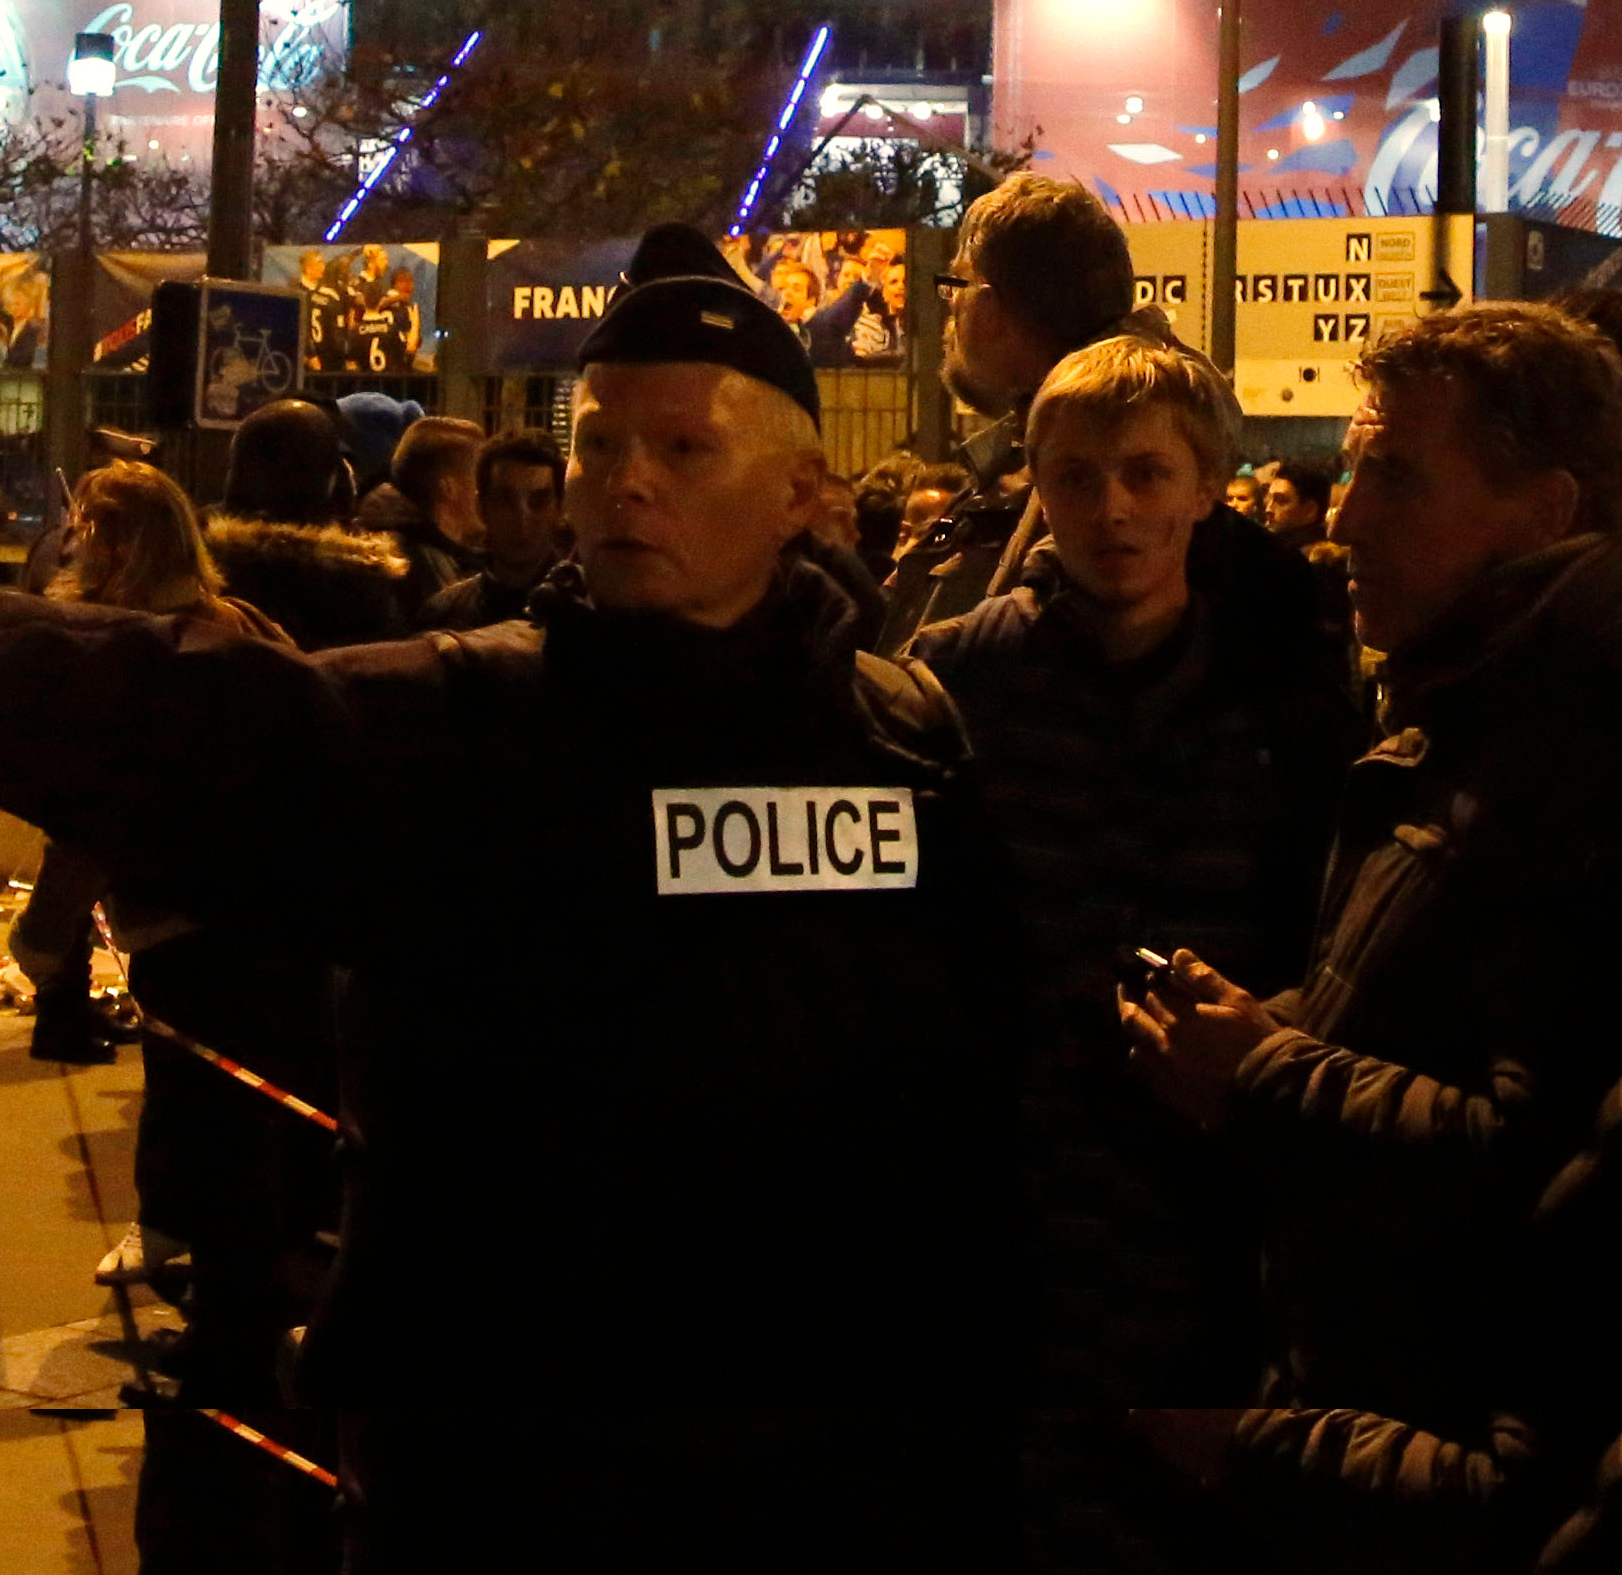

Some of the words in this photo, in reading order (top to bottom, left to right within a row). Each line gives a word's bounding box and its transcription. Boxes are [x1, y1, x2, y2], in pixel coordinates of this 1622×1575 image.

[68, 2, 341, 93] Coca-Cla
[1348, 237, 1369, 262] N
[513, 285, 618, 319] FRAN
[1135, 280, 1155, 304] D
[1164, 280, 1182, 304] C
[1258, 278, 1273, 304] S
[1287, 278, 1304, 303] T
[1318, 278, 1337, 303] U
[1348, 277, 1367, 303] X
[311, 308, 323, 343] 5
[1317, 318, 1336, 343] Y
[1348, 318, 1366, 343] Z
[369, 336, 387, 372] 6
[666, 799, 906, 879] POLICE
